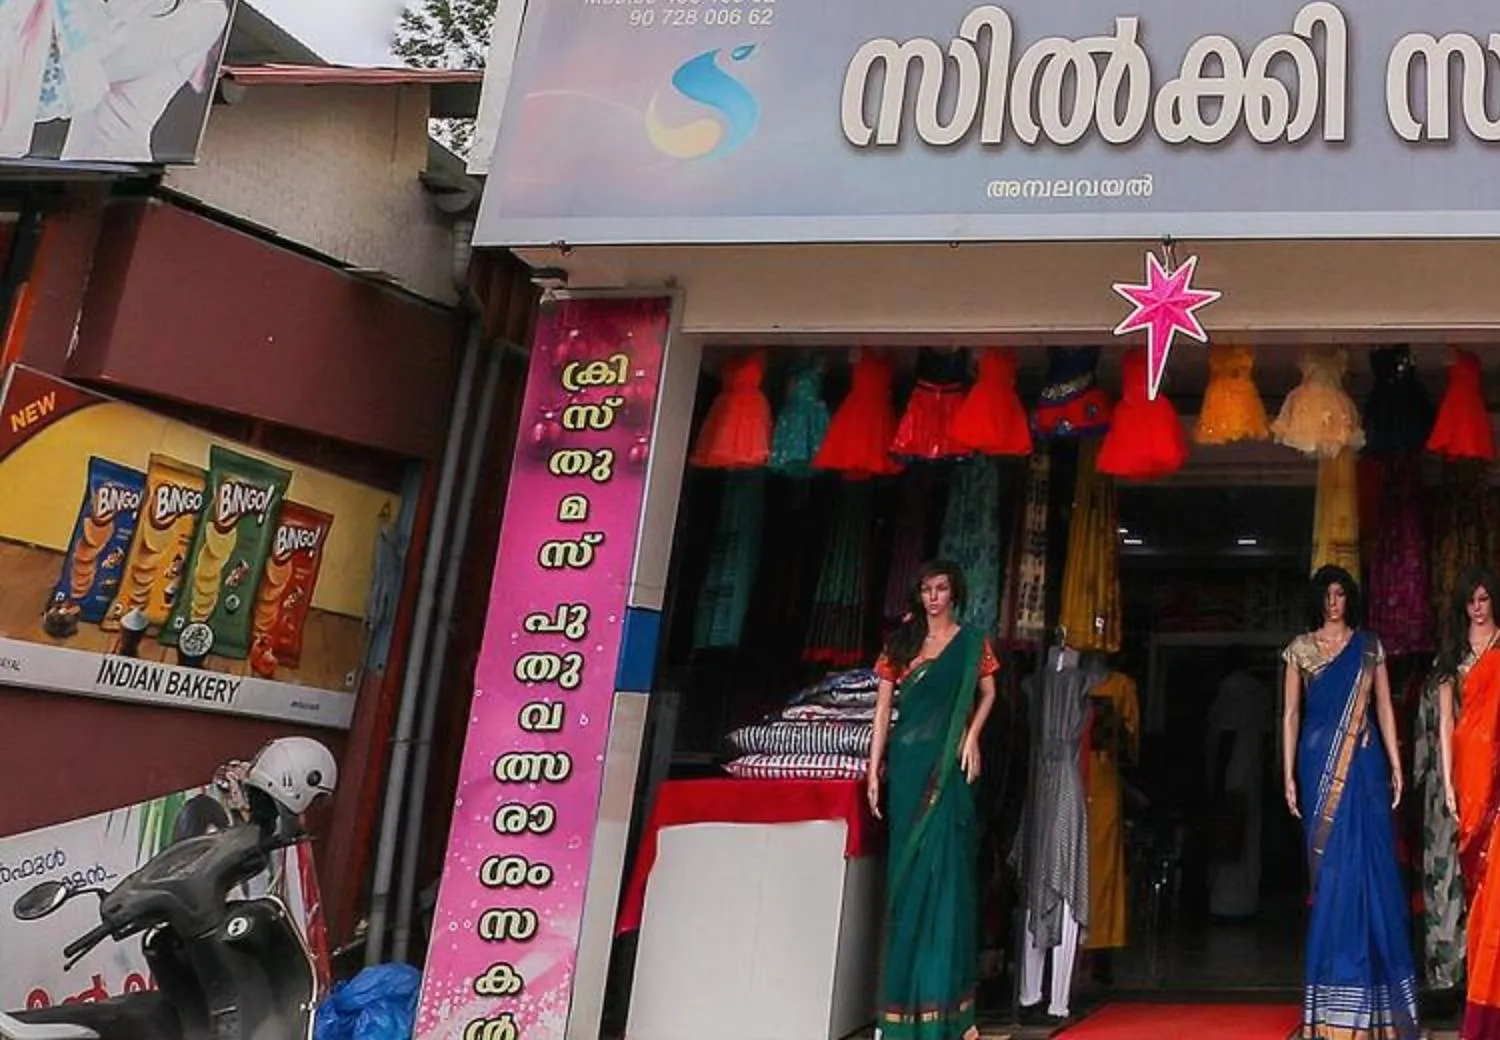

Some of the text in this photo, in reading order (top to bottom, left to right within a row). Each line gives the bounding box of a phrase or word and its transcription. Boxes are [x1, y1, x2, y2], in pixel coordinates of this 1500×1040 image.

[629, 8, 774, 26] 90 728 006 62
[10, 391, 57, 433] NEW
[215, 481, 275, 524] BINGO!
[96, 658, 240, 704] INDIAN BAKERY
